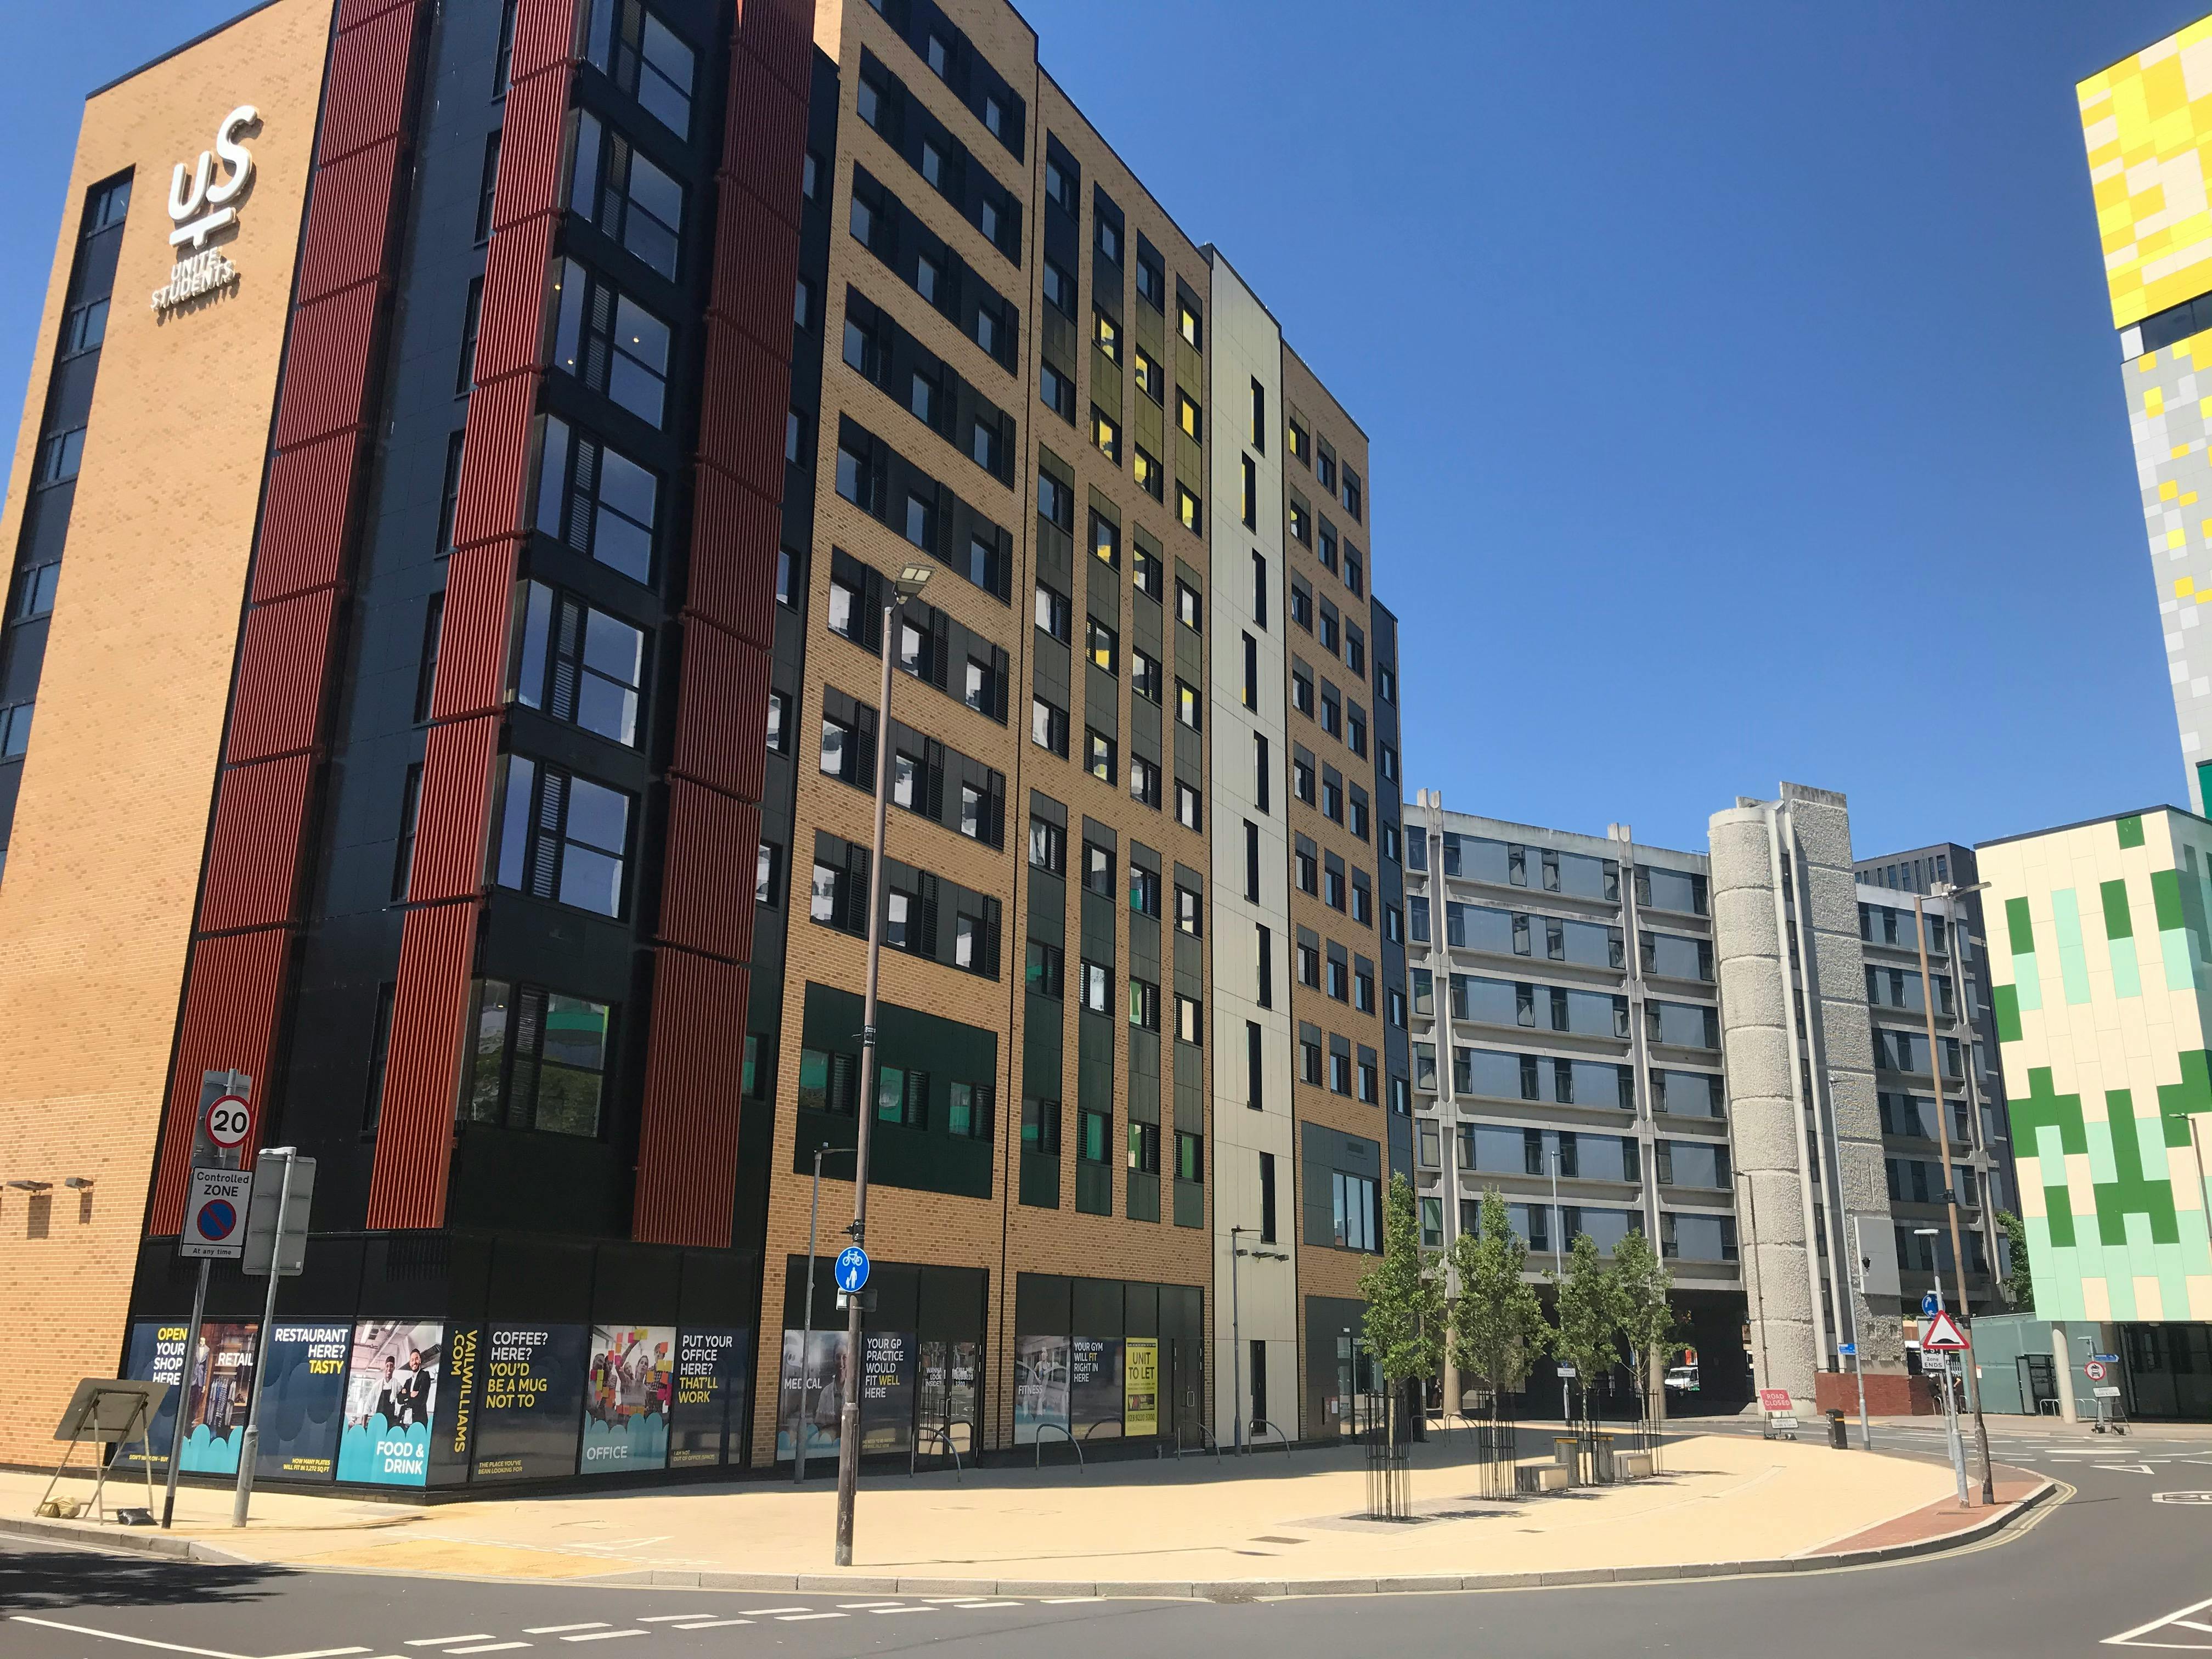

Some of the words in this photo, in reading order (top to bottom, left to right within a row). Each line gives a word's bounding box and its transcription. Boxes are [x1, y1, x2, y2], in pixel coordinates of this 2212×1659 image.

[171, 246, 221, 281] UNITE
[150, 261, 236, 311] STUDENTS
[213, 1110, 247, 1133] 20
[196, 1171, 249, 1184] Controlled
[204, 1184, 239, 1197] ZONE
[203, 1248, 215, 1256] any
[158, 1328, 188, 1340] OPEN
[275, 1329, 348, 1342] RESTAURANT
[493, 1331, 548, 1346] COFFEE?
[682, 1335, 703, 1347] PUT
[704, 1335, 732, 1348] YOUR
[867, 1338, 889, 1348] YOUR
[891, 1338, 902, 1349] GP
[1074, 1342, 1090, 1351] YOUR
[1091, 1342, 1103, 1351] GYM
[157, 1342, 185, 1356] YOUR
[308, 1344, 346, 1358] HERE?
[450, 1330, 465, 1375] .COM
[491, 1347, 532, 1361] HERE?
[681, 1349, 717, 1361] OFFICE
[218, 1352, 253, 1367] RETAIL
[866, 1350, 904, 1362] PRACTICE
[1074, 1353, 1088, 1362] WILL
[1089, 1352, 1098, 1362] FIT
[1132, 1352, 1150, 1365] UNIT
[154, 1357, 183, 1370] SHOP
[309, 1360, 345, 1374] TASTY
[489, 1363, 529, 1376] YOU'D
[680, 1362, 713, 1375] HERE?
[866, 1363, 896, 1374] WOULD
[1074, 1363, 1091, 1373] RIGHT
[1092, 1363, 1098, 1372] IN
[153, 1372, 181, 1385] HERE
[865, 1375, 877, 1386] FIT
[879, 1374, 900, 1386] WELL
[1074, 1374, 1089, 1383] HERE
[1128, 1367, 1139, 1380] TO
[1141, 1367, 1155, 1380] LET
[488, 1379, 504, 1392] BE
[506, 1378, 516, 1392] A
[518, 1378, 547, 1392] MUG
[680, 1376, 718, 1390] THAT'LL
[785, 1378, 822, 1389] MEDCAL
[454, 1330, 478, 1453] VAILWILLIAMS
[865, 1387, 886, 1398] HERE
[1018, 1385, 1042, 1395] FITNESS
[486, 1395, 515, 1409] NOT
[518, 1394, 534, 1408] TO
[679, 1391, 710, 1403] WORK
[377, 1441, 413, 1456] FOOD
[415, 1443, 424, 1457] &
[586, 1445, 628, 1460] OFFICE
[385, 1458, 423, 1474] DRINK
